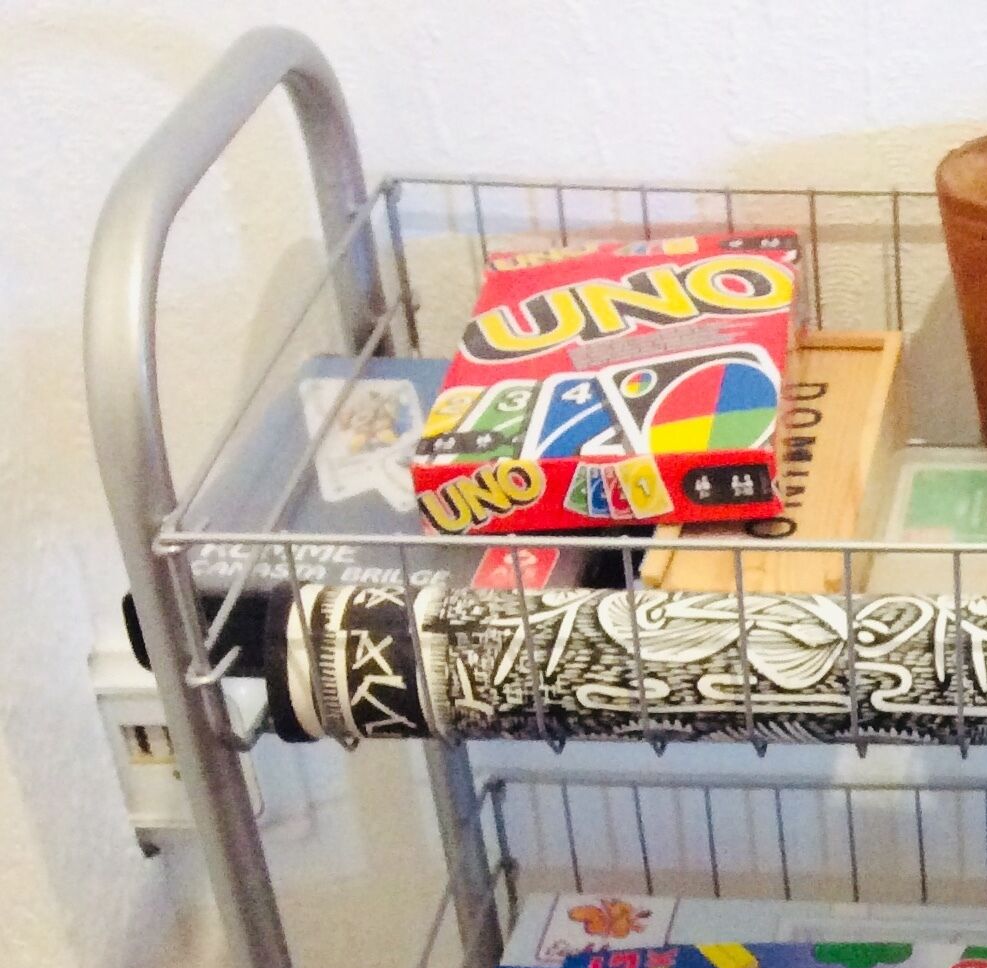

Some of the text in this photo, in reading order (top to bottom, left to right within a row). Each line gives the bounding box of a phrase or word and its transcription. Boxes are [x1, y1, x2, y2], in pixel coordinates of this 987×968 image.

[462, 254, 794, 363] UNO
[498, 388, 533, 412] 3
[561, 382, 594, 404] 4
[416, 460, 546, 534] UNO
[746, 382, 829, 538] DOMINO
